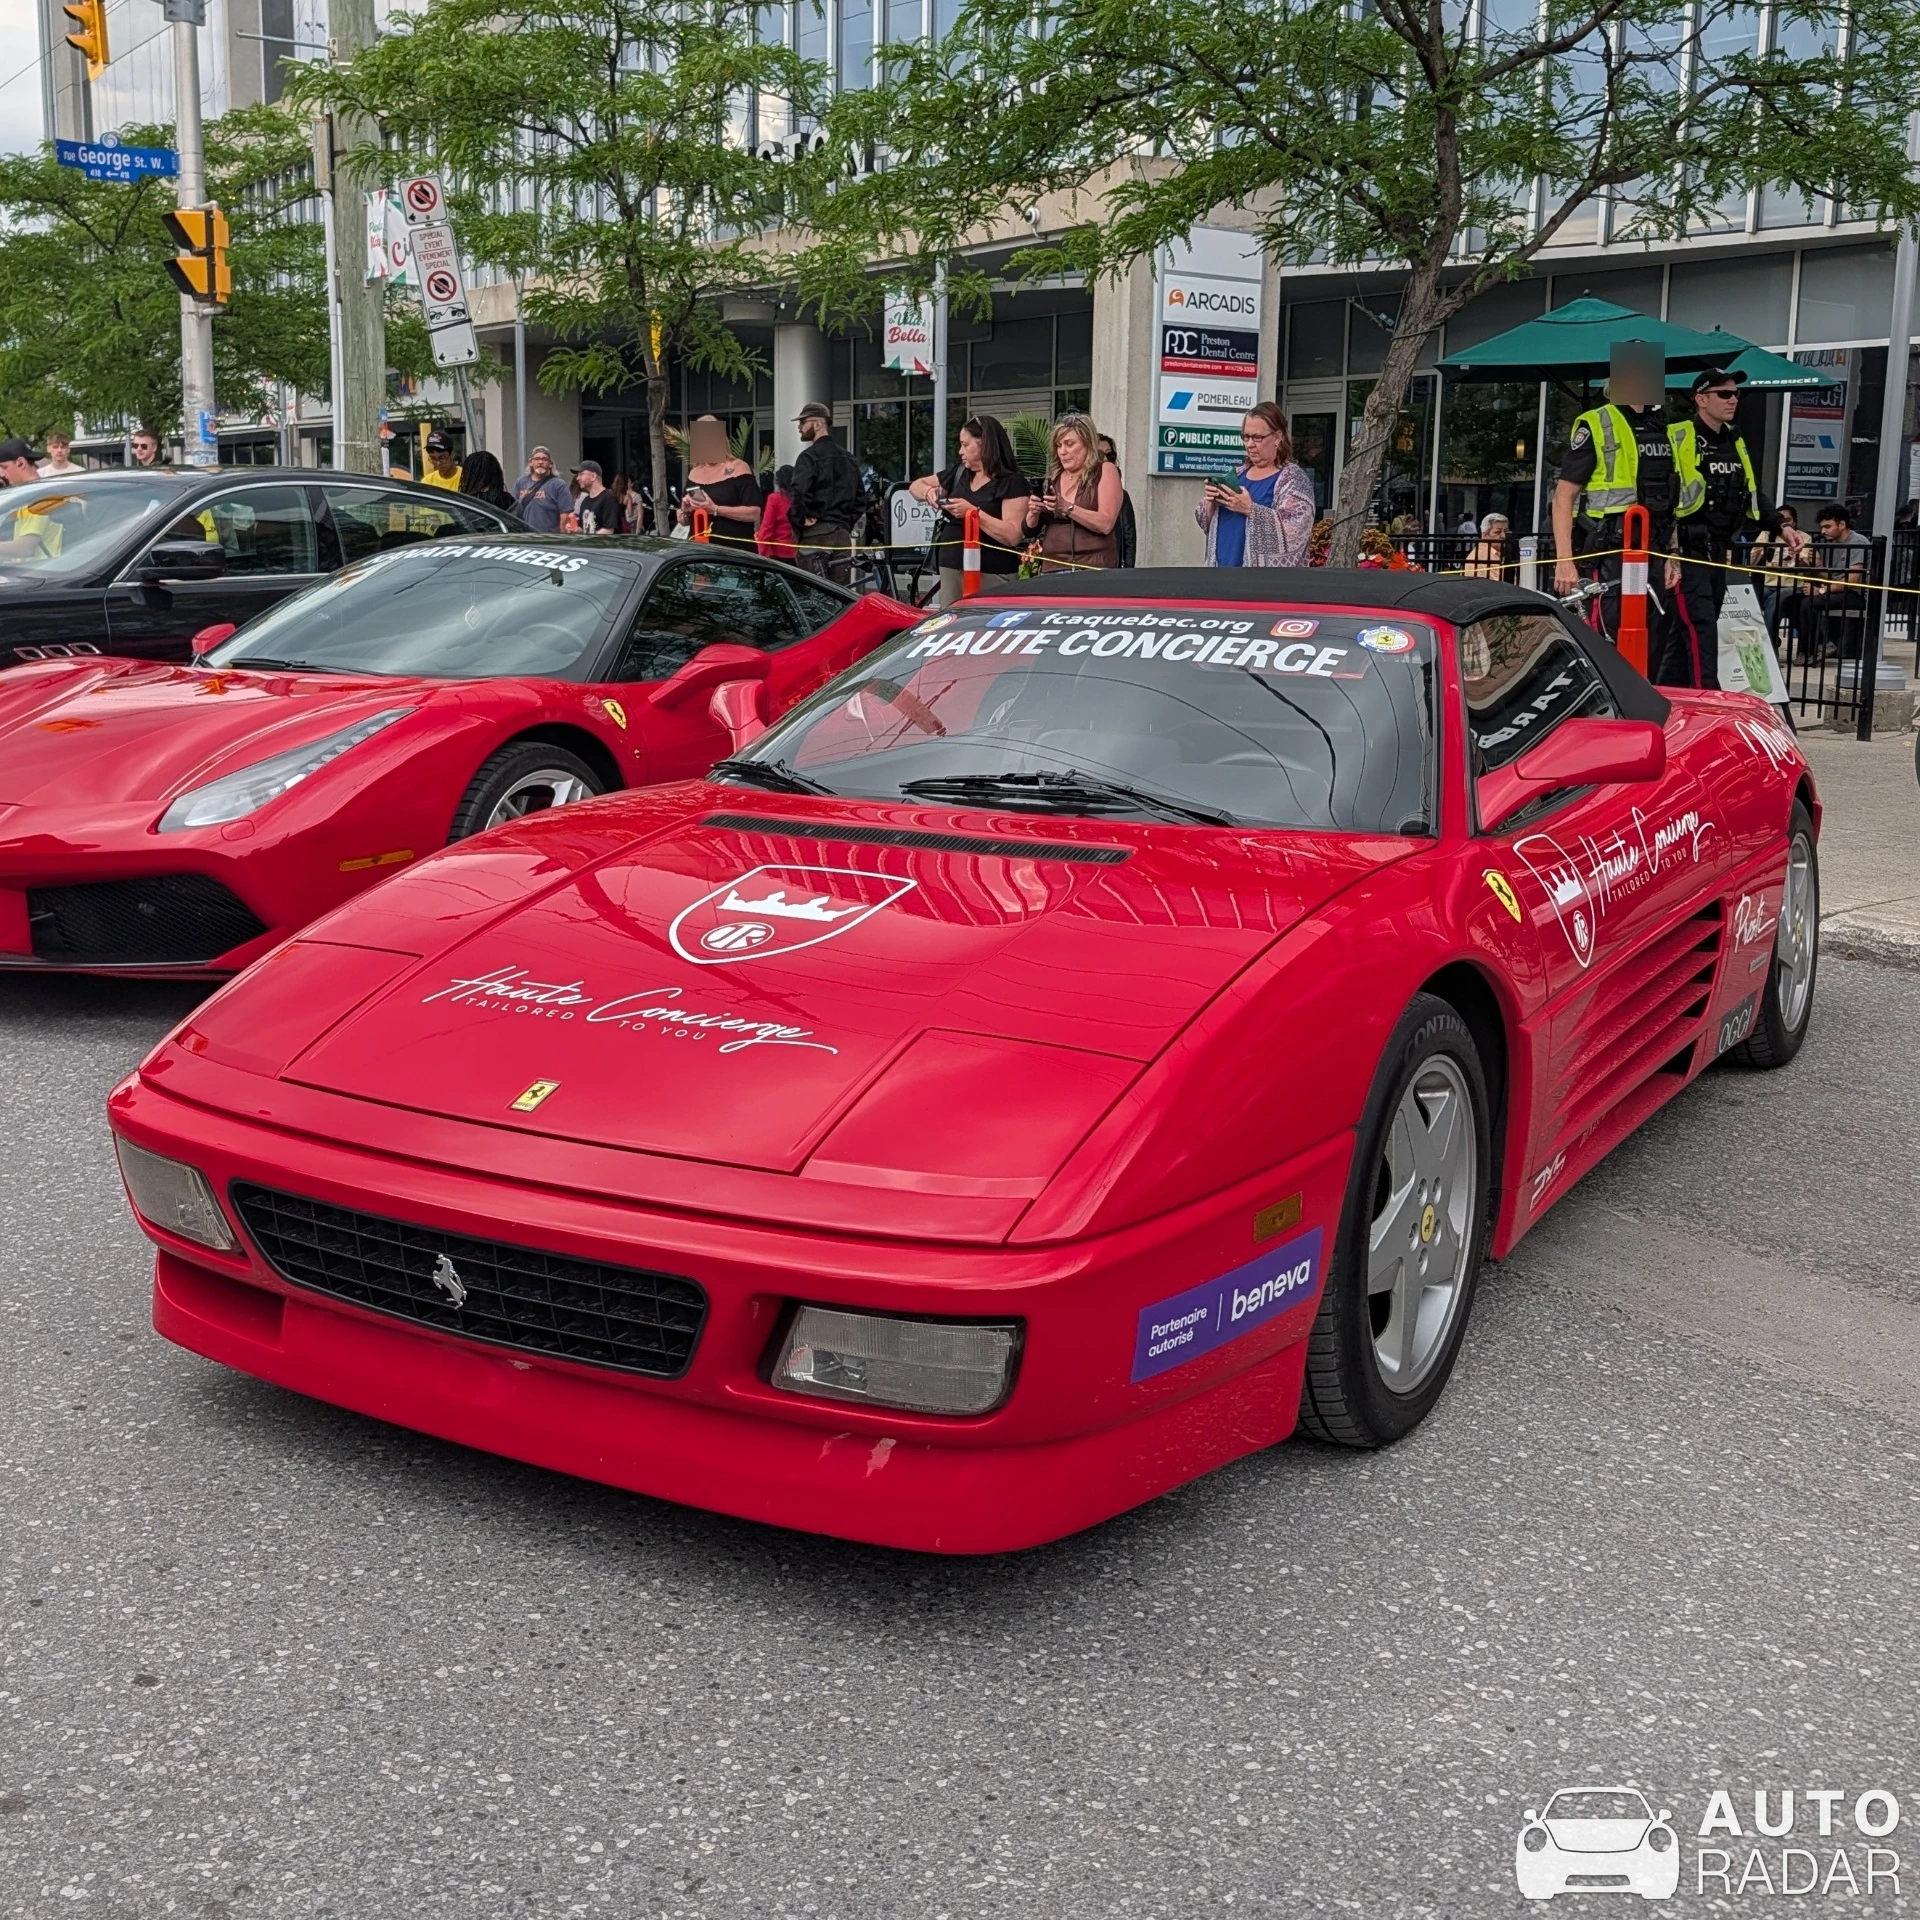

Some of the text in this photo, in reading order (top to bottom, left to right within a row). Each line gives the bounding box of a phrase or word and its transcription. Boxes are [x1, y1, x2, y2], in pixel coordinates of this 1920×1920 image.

[63, 150, 76, 162] rue
[78, 145, 131, 171] George
[134, 156, 148, 169] St.
[150, 157, 165, 170] W.
[424, 240, 444, 250] EVENT
[425, 261, 451, 271] SPECIAL
[1185, 291, 1256, 315] ARCADIS
[887, 326, 927, 344] Bella
[1165, 329, 1231, 356] PDC Preston
[1201, 346, 1256, 361] Dental Centre
[1750, 377, 1819, 385] STARBUCKS
[1197, 392, 1252, 407] POMERLEAU
[1179, 432, 1211, 444] PUBLIC
[1213, 434, 1244, 447] PARKIN
[1638, 443, 1671, 457] POLICE
[1185, 455, 1202, 464] Leasing
[470, 545, 589, 572] WHEELS
[1040, 612, 1255, 634] fcaquebec.org
[906, 629, 1061, 659] HAUTE
[1057, 629, 1348, 678] CONCIERGE
[1578, 806, 1715, 917] Haute Concierge
[1612, 847, 1687, 902] TAILORED TO YOU
[422, 965, 839, 1055] Haute Concierge
[466, 996, 707, 1041] TAILORED TO YOU
[1151, 1258, 1312, 1341] Partenaire beneva
[1148, 1326, 1194, 1358] autorisé
